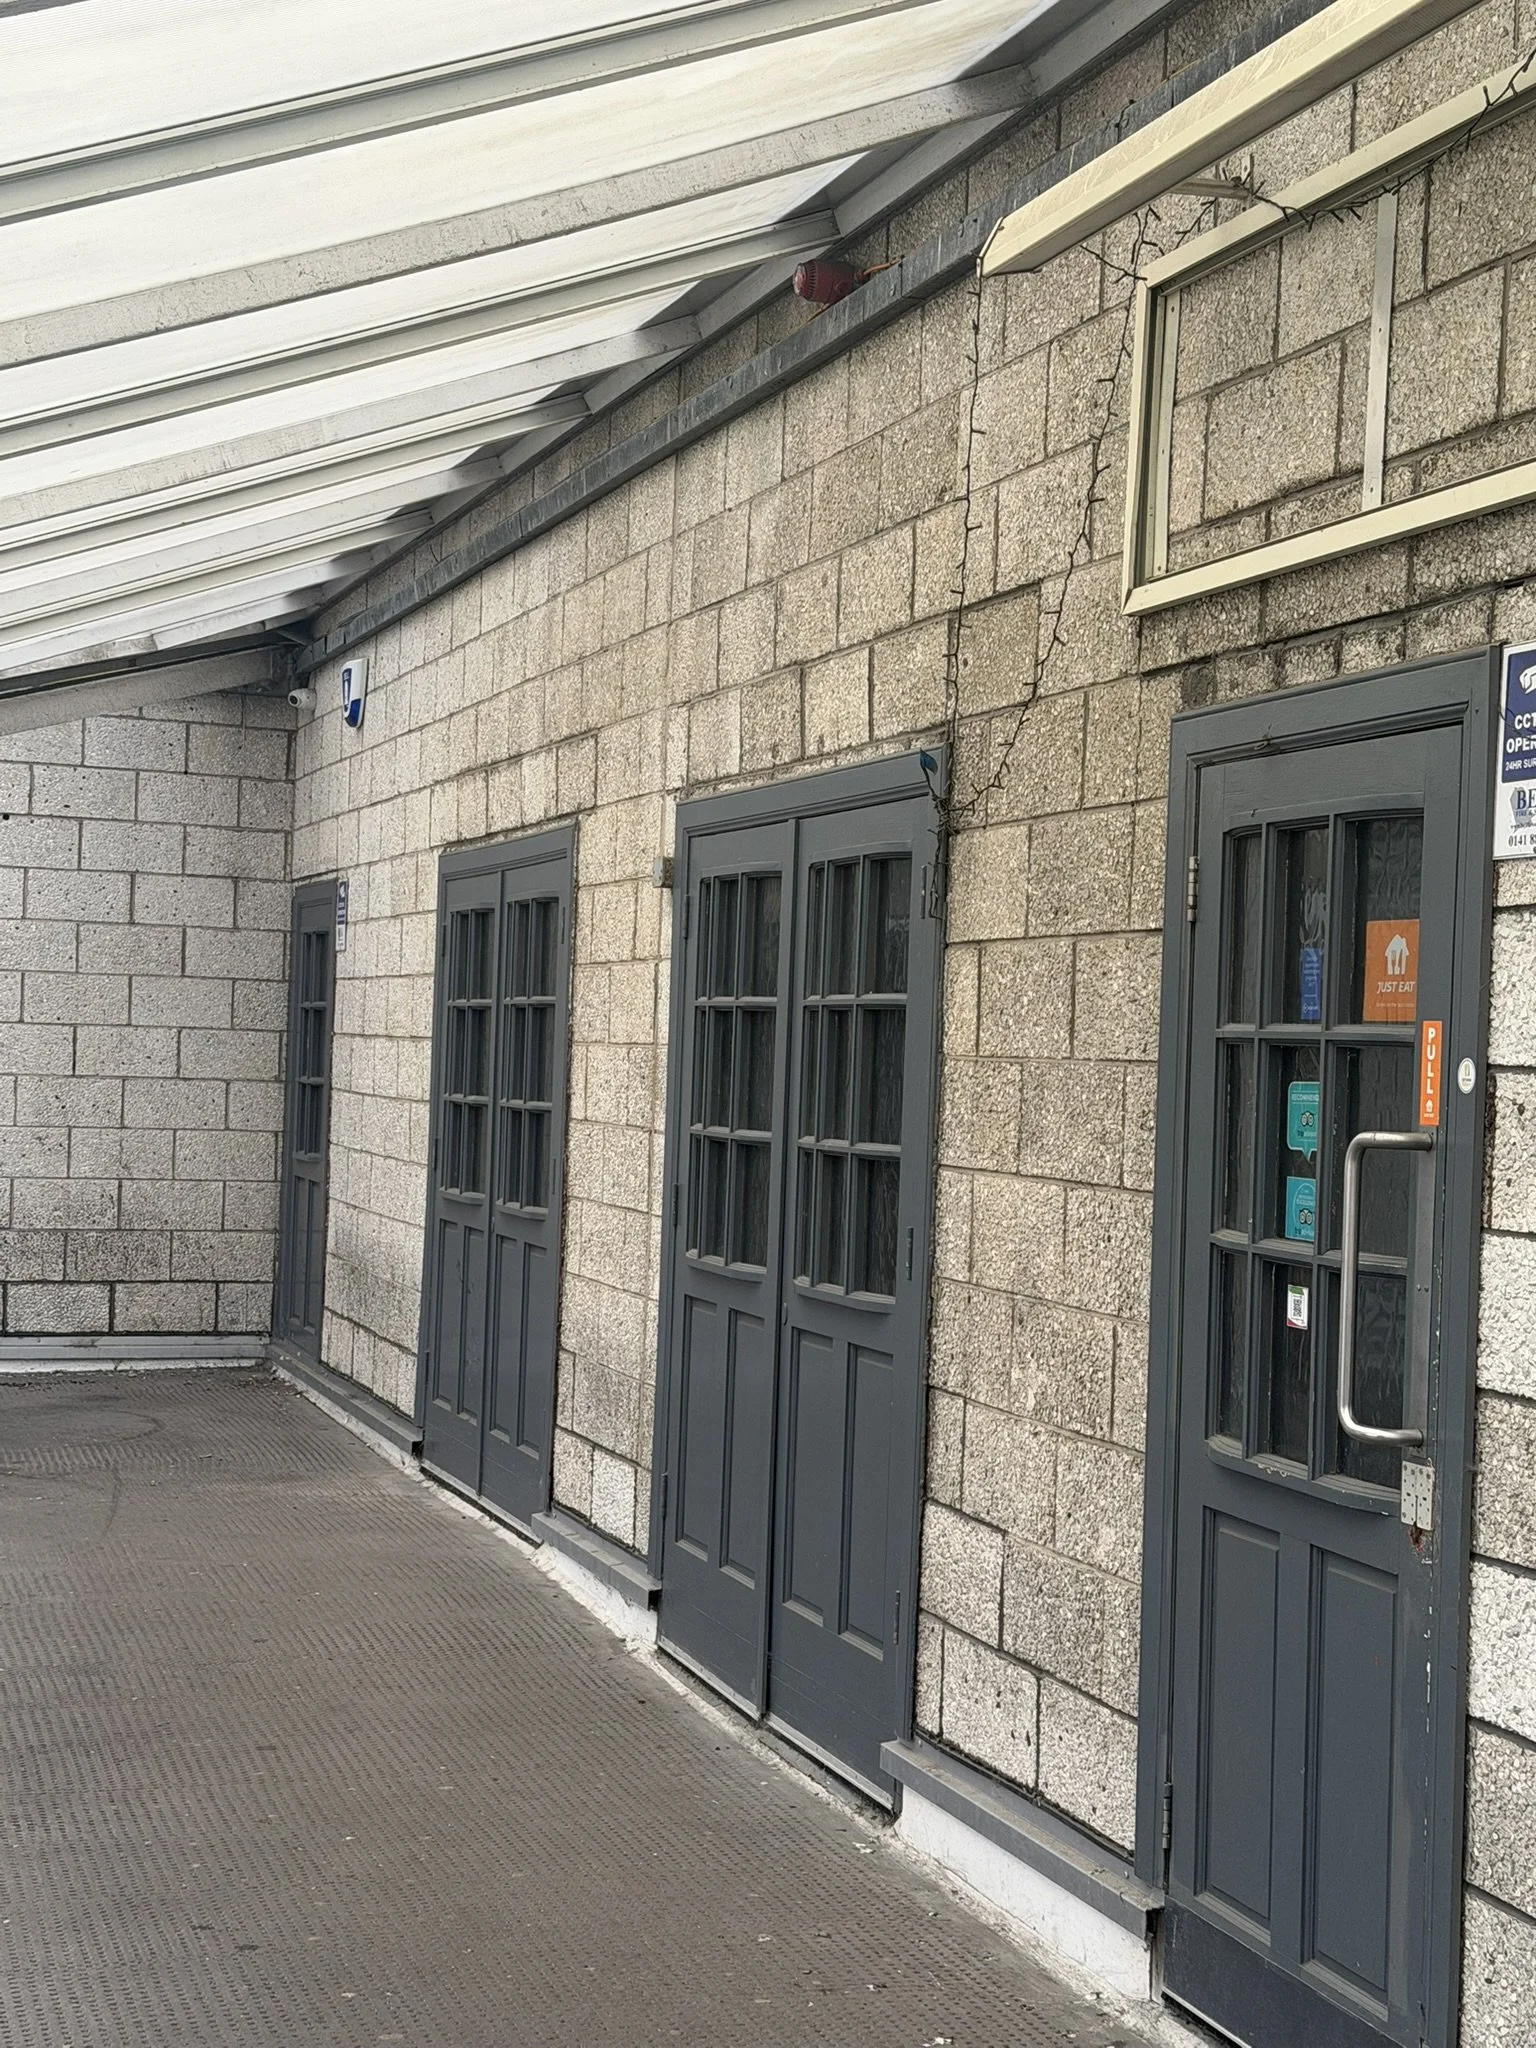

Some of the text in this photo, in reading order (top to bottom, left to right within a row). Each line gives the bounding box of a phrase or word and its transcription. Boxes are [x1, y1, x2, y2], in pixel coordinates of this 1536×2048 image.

[1505, 760, 1522, 771] 24HR
[1508, 834, 1526, 847] 0141
[1376, 981, 1416, 994] JUST EAT
[1426, 1027, 1437, 1095] PULL
